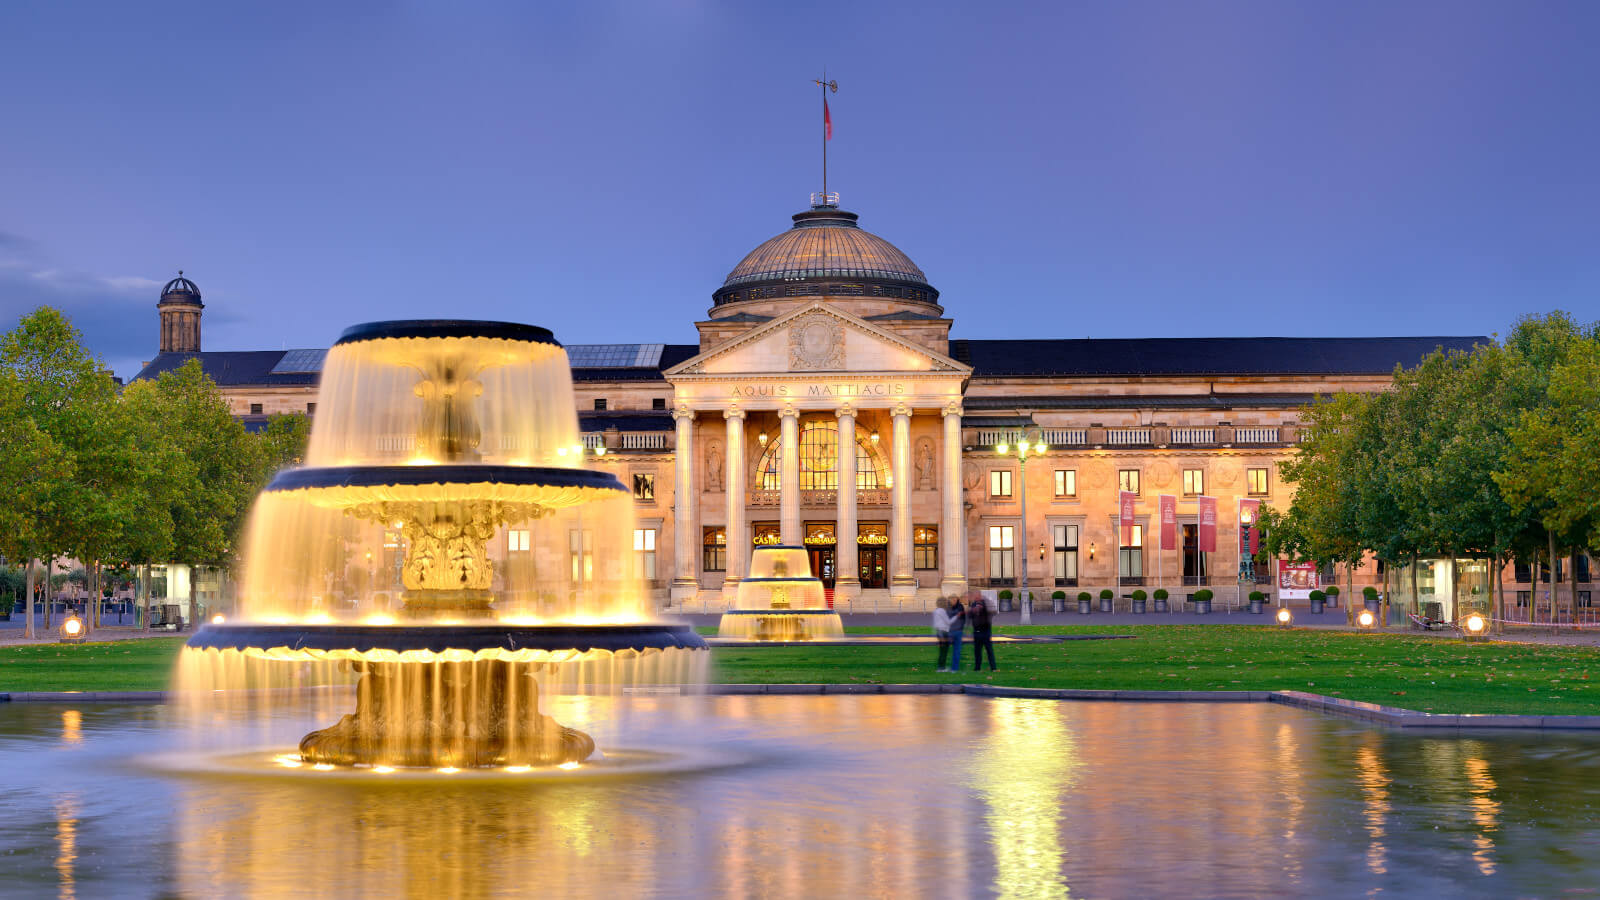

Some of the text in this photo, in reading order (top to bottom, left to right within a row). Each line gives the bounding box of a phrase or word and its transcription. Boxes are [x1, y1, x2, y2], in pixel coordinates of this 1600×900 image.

[731, 383, 904, 397] AQUIS MATTIACIS
[856, 536, 888, 544] CASINO
